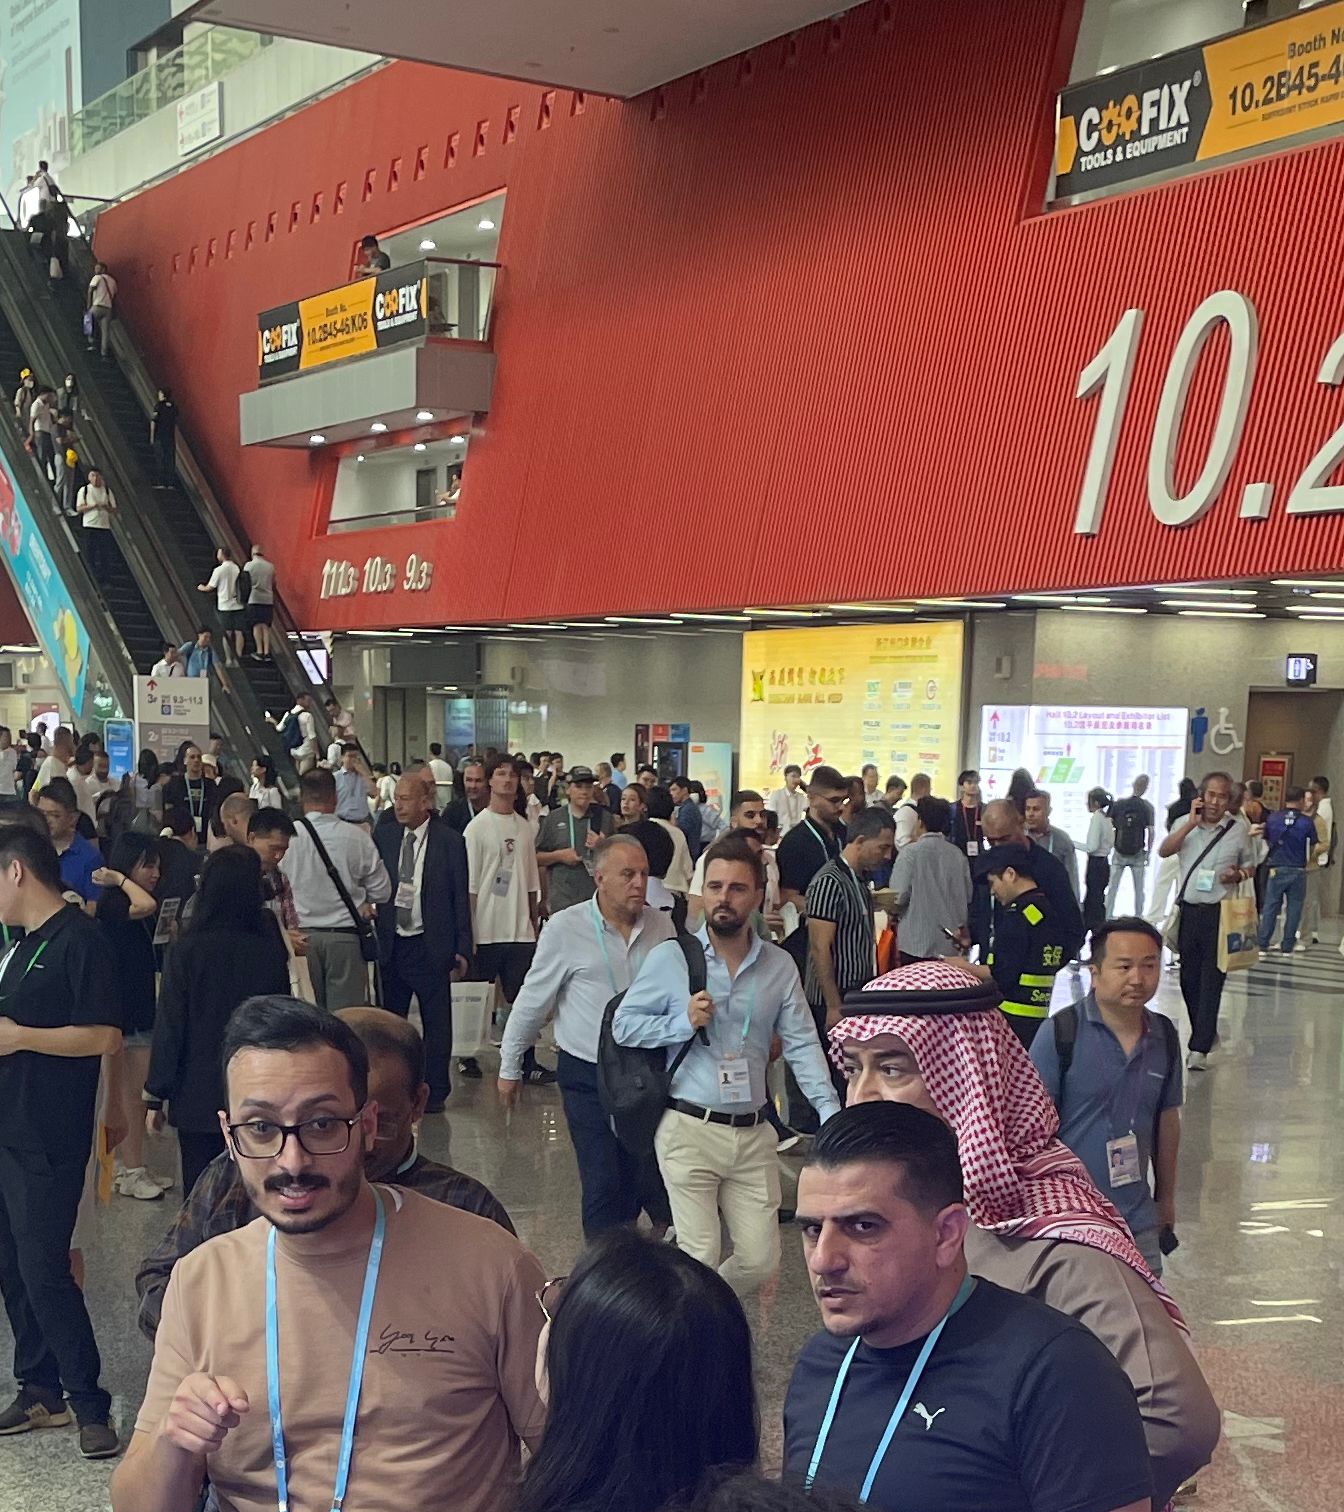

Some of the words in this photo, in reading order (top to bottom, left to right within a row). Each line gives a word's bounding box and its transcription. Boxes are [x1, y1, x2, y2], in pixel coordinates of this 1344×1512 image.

[1287, 34, 1327, 60] Booth
[1080, 149, 1114, 173] TOOLS
[1115, 146, 1124, 163] &
[1125, 126, 1189, 160] EQUIPMENT
[362, 555, 395, 594] 10.3
[402, 552, 432, 591] 9.3
